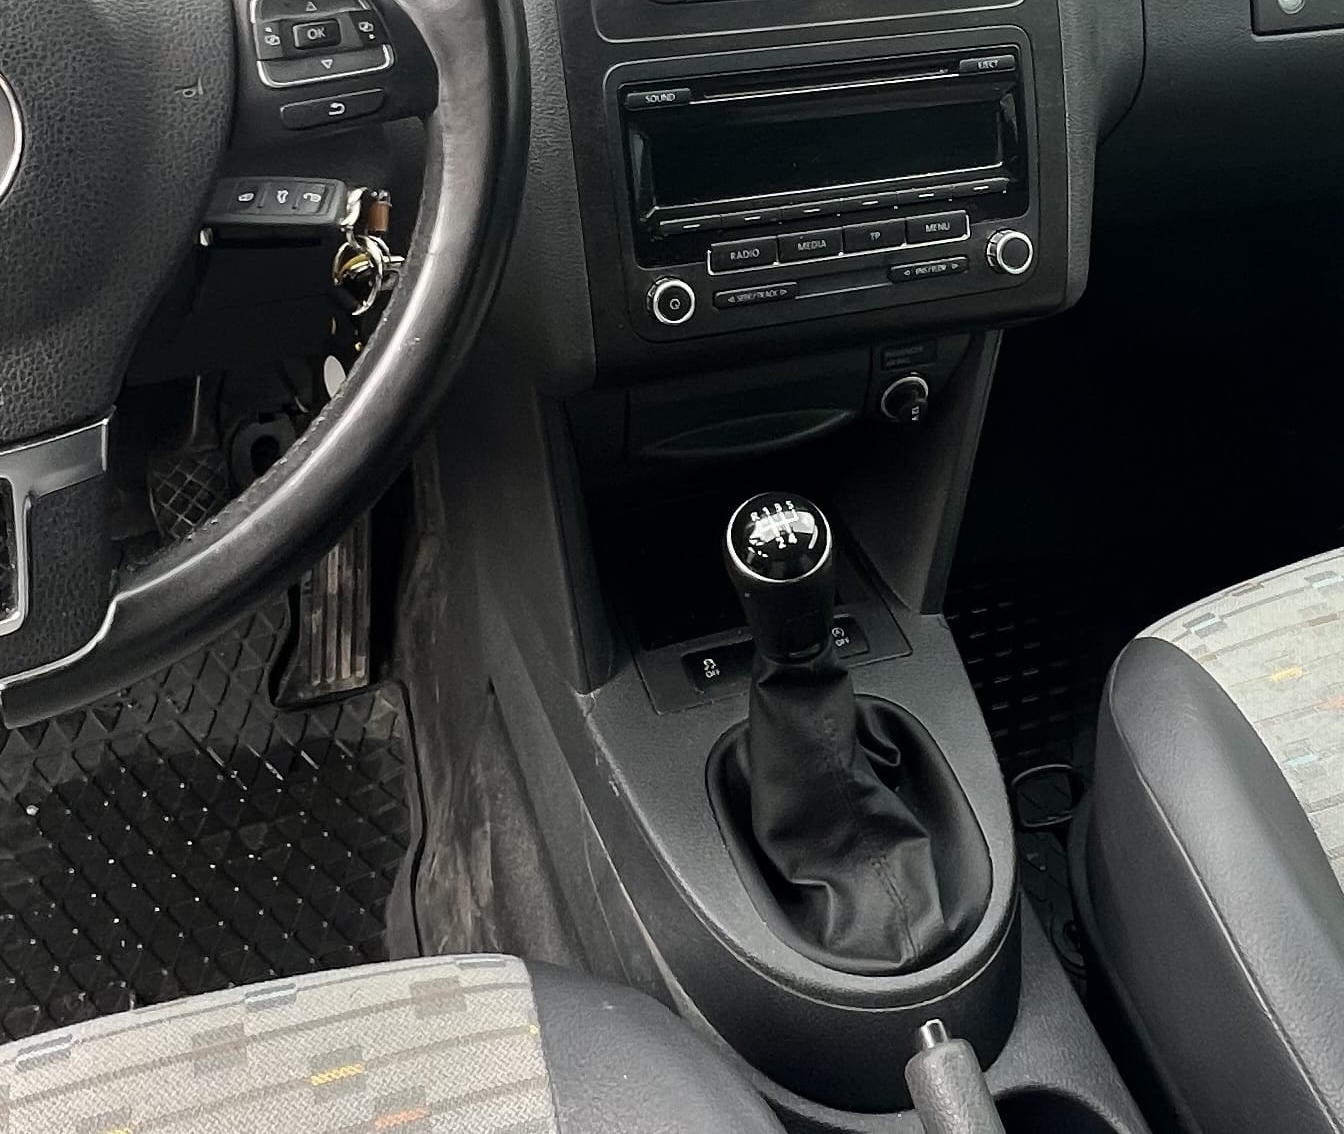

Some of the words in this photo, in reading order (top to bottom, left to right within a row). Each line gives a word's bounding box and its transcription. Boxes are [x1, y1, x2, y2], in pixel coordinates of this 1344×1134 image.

[307, 26, 327, 40] OK
[645, 92, 677, 104] SOUND
[729, 247, 761, 261] RADIO
[797, 238, 828, 251] MEDIA
[869, 232, 882, 242] TP
[925, 222, 951, 233] MENU
[785, 500, 795, 511] 5
[776, 536, 787, 550] 2
